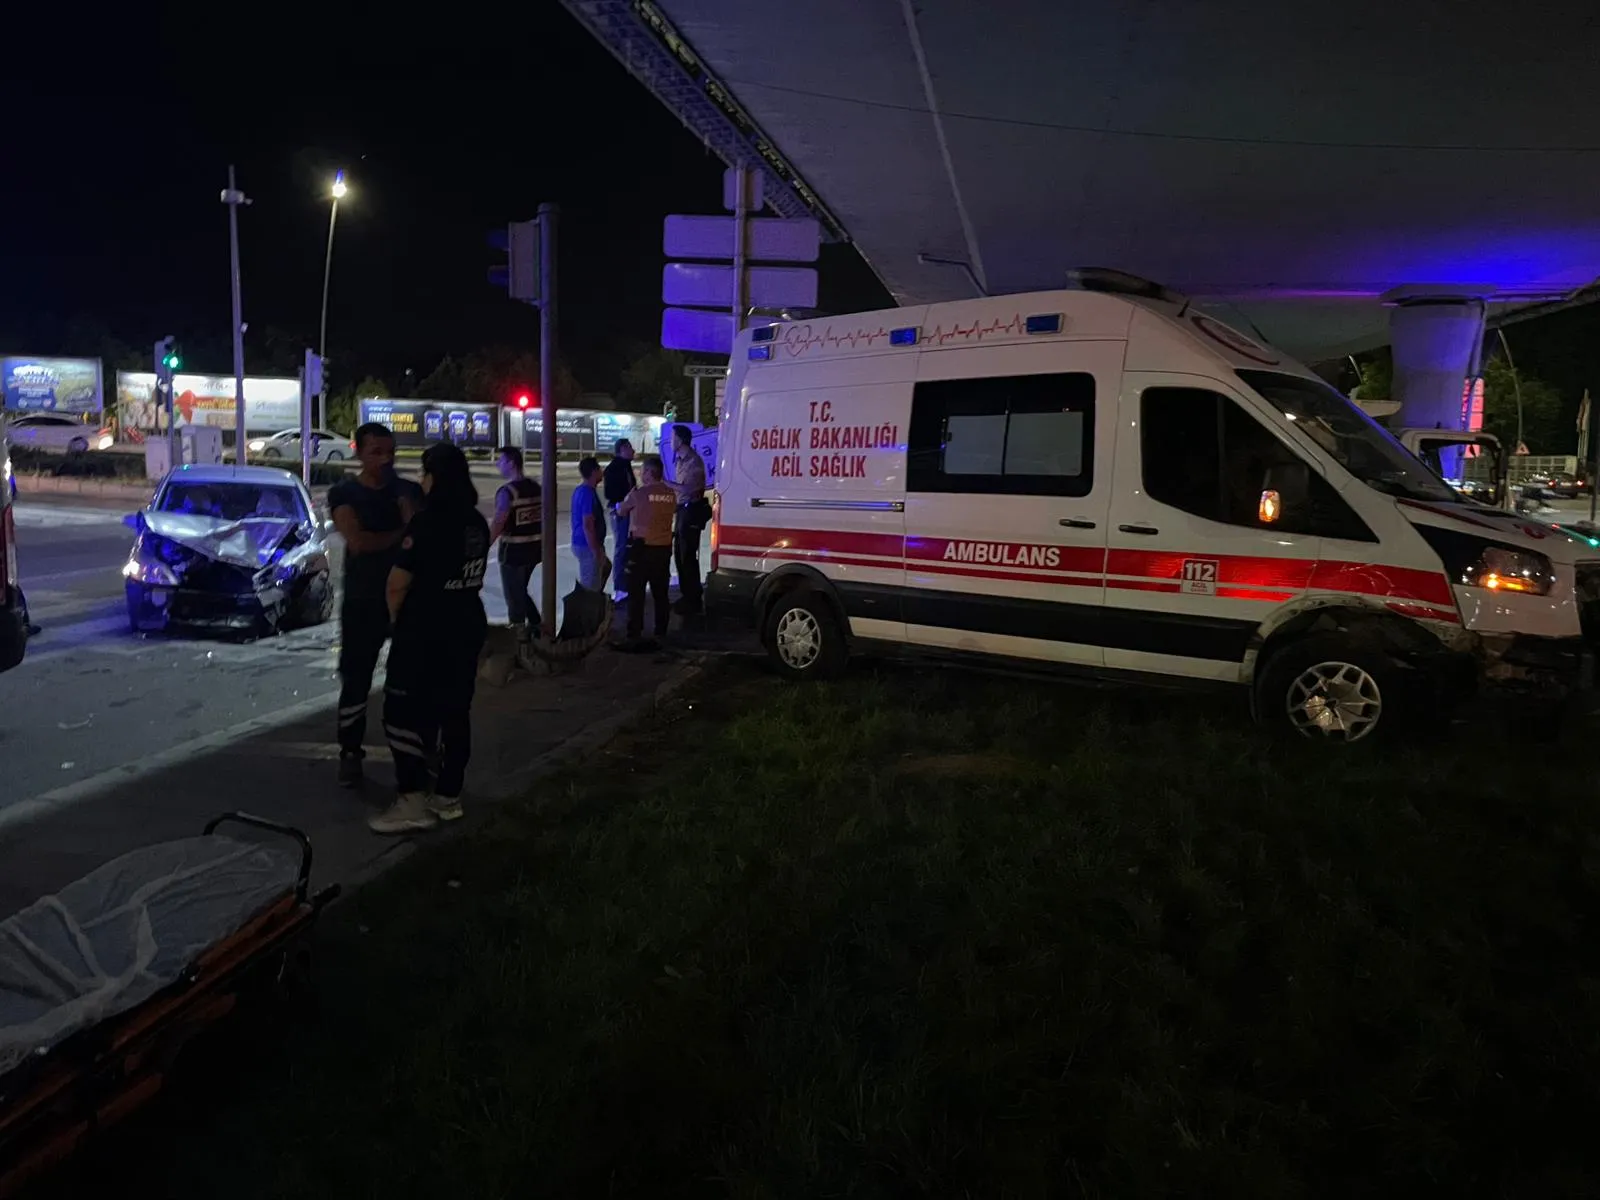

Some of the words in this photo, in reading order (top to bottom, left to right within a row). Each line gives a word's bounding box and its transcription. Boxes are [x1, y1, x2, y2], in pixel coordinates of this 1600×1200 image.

[809, 401, 834, 422] T.C.
[751, 425, 802, 449] SAĞLIK
[809, 421, 898, 448] BAKANLIĞI
[771, 452, 803, 477] ACİL
[809, 451, 867, 478] SAĞLIK
[943, 541, 1061, 568] AMBULANS
[462, 558, 485, 578] 112
[1185, 562, 1215, 581] 112
